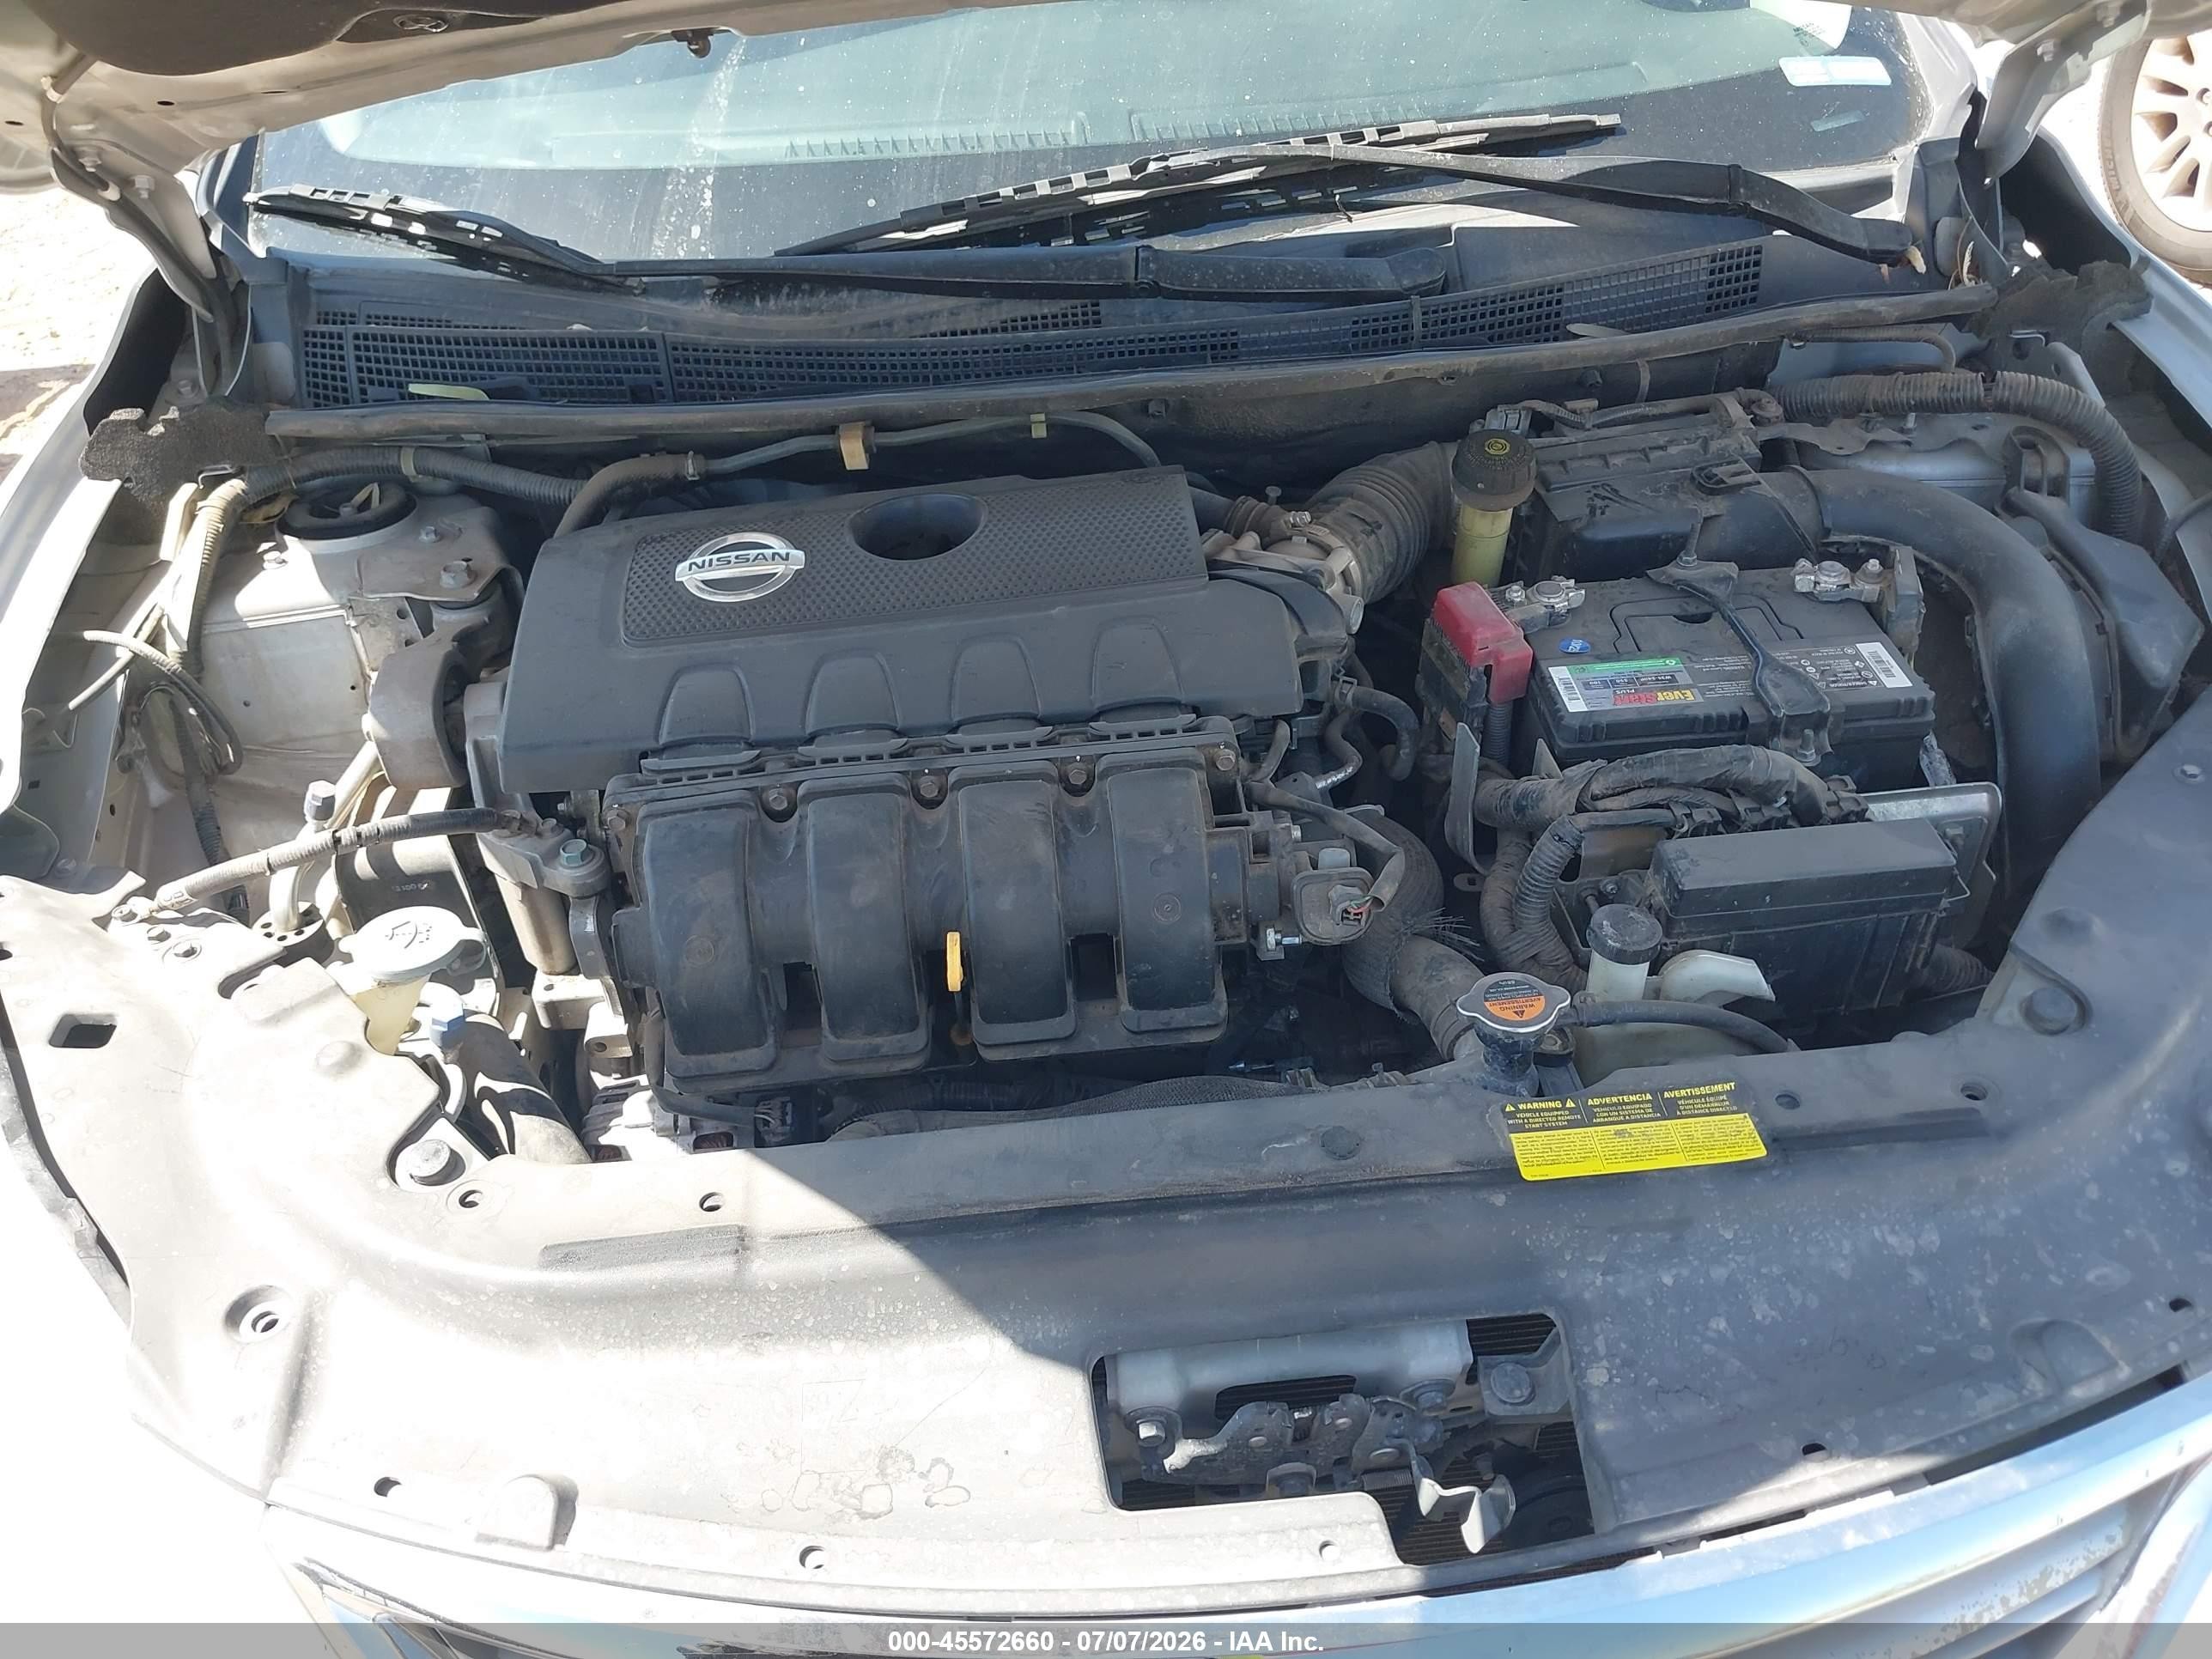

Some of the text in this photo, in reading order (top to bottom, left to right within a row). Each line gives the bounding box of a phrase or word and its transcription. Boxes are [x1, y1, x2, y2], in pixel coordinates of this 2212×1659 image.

[688, 552, 790, 572] NISSAN
[1614, 690, 1694, 706] EverStart
[1499, 1003, 1535, 1012] WARNING
[1663, 1082, 1735, 1098] AVERTISSEMENT
[1517, 1100, 1562, 1109] WARNING
[1587, 1093, 1653, 1106] ADVERTENCIA
